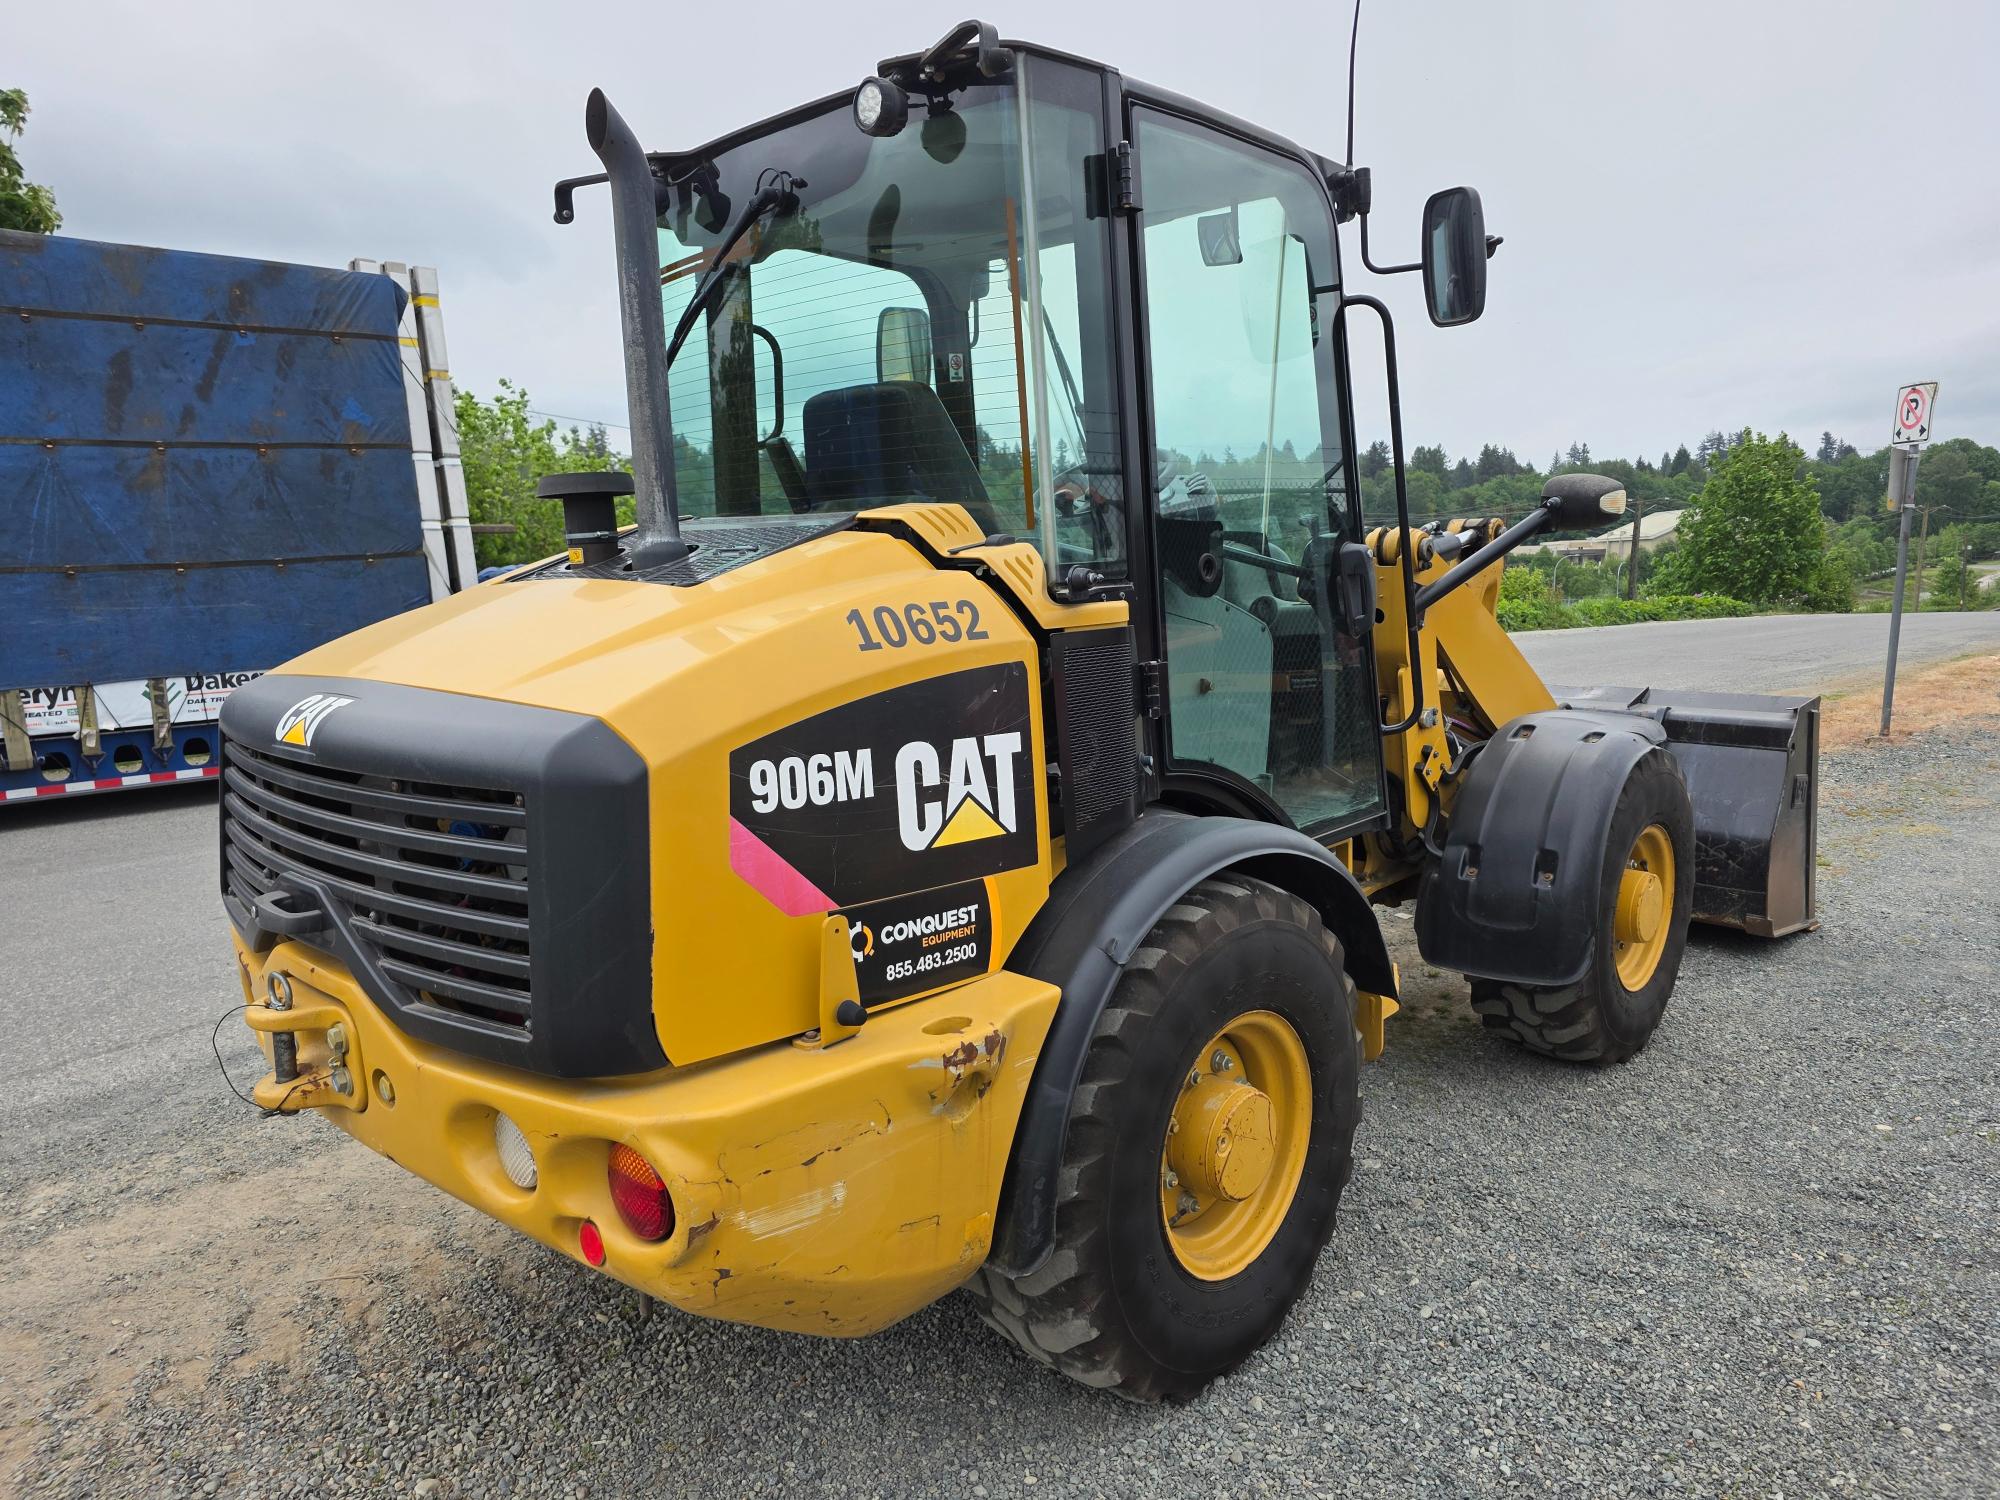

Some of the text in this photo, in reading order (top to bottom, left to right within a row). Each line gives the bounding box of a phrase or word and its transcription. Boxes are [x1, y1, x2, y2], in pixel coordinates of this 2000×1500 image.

[846, 600, 989, 652] 10652
[275, 694, 355, 747] CAT
[750, 731, 1022, 851] 906M CAT
[880, 904, 979, 945] CONQUEST
[922, 924, 977, 948] EQUIPMENT
[886, 942, 977, 981] 855.483.2500
